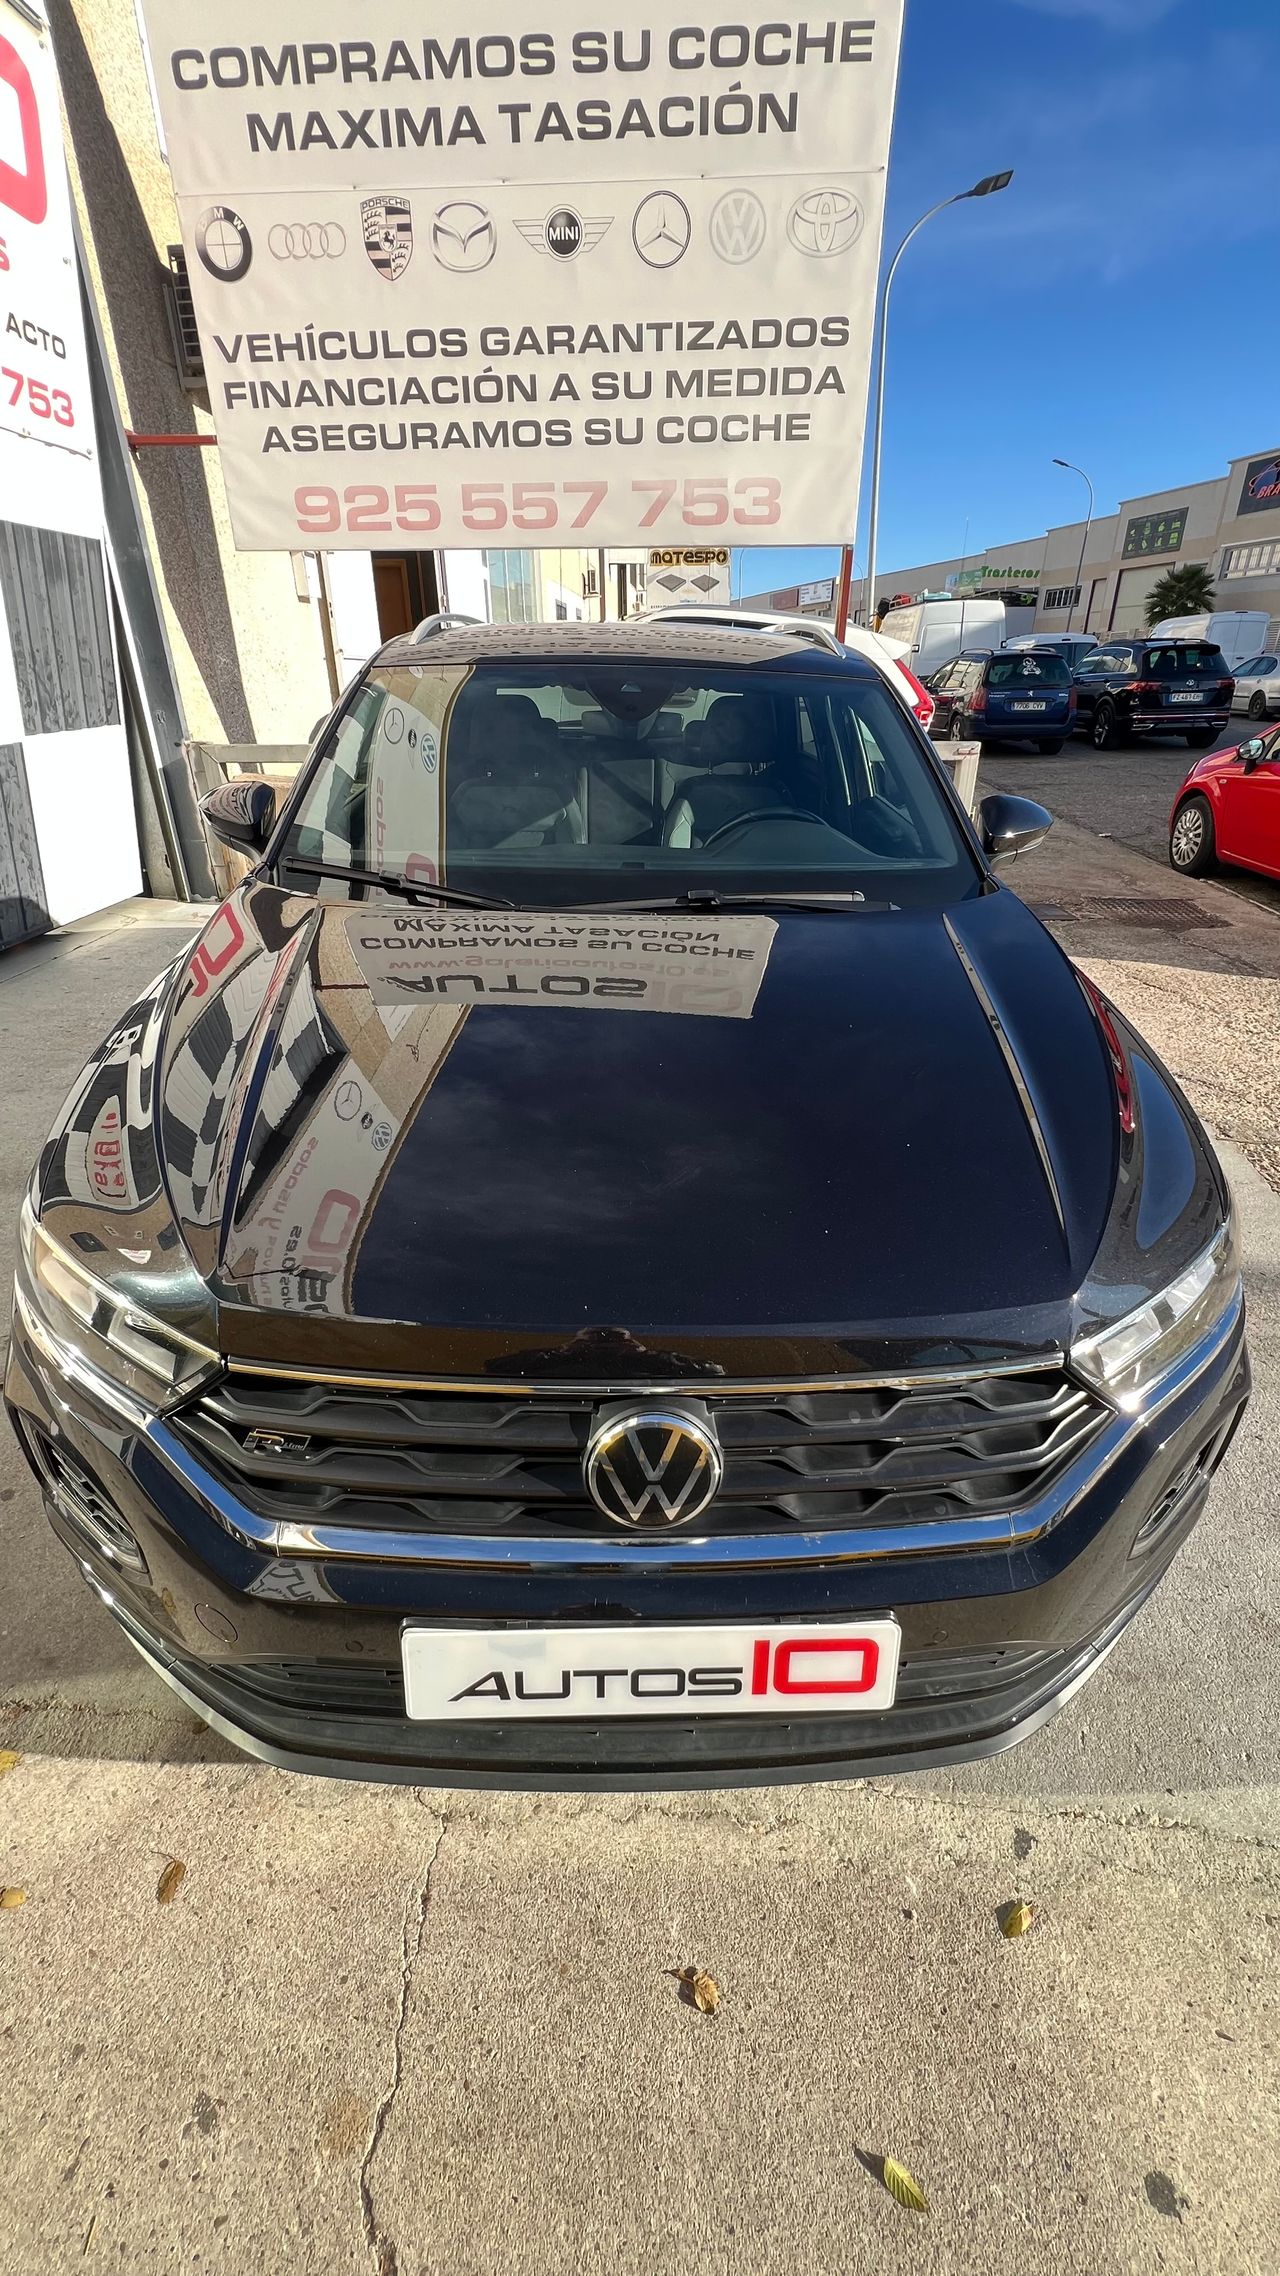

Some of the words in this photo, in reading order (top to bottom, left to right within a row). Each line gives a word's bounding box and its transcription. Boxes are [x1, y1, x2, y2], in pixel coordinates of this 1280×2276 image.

[171, 33, 556, 90] COMPRAMOS
[572, 28, 651, 74] SU
[669, 20, 876, 70] COCHE
[246, 105, 487, 152] MAXIMA
[498, 81, 798, 143] TASACIÓN
[361, 198, 410, 210] PORSCHE
[549, 226, 580, 241] MINI
[6, 312, 67, 360] ACTO
[213, 323, 468, 363] VEHÍCULOS
[480, 316, 850, 357] GARANTIZADOS
[1, 366, 75, 428] 753
[224, 366, 538, 409] FINANCIACIÓN
[549, 373, 580, 401] A
[592, 371, 652, 400] SU
[666, 366, 846, 398] MEDIDA
[262, 419, 572, 453] ASEGURAMOS
[584, 417, 643, 446] SU
[657, 413, 811, 444] COCHE
[294, 484, 441, 533] 925
[461, 481, 609, 530] 557
[631, 478, 782, 527] 753
[980, 565, 1041, 579] Trasteros
